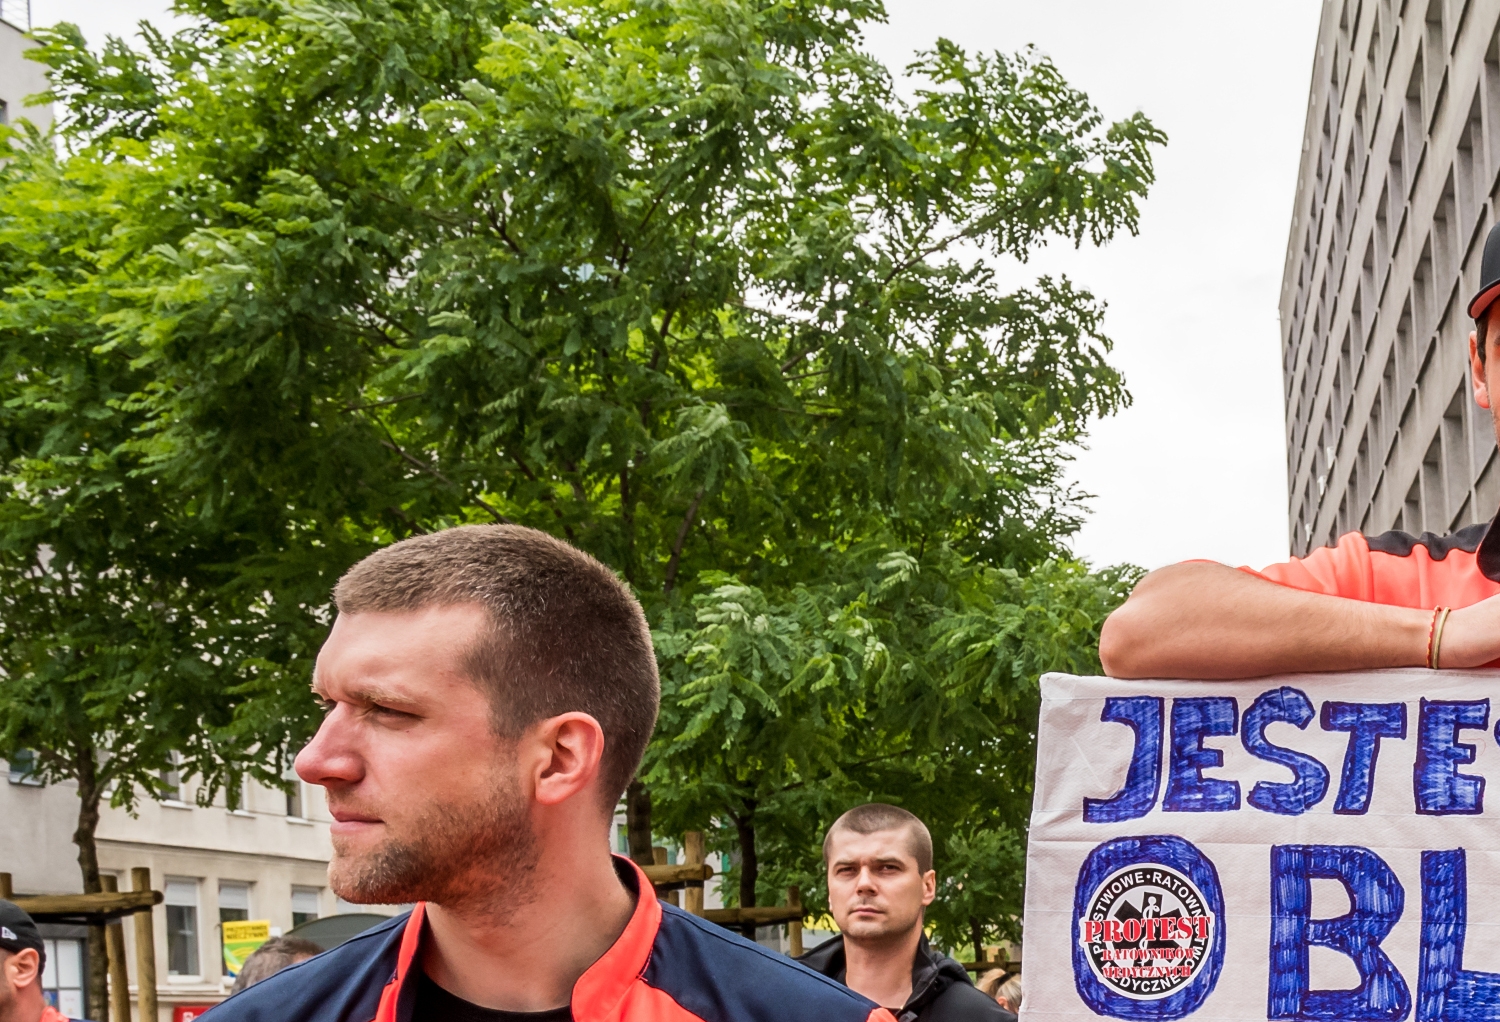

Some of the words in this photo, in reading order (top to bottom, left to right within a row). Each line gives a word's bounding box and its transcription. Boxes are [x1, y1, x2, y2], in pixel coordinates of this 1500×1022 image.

[1084, 916, 1211, 943] PROTEST
[1102, 947, 1195, 961] RATOWNIKÓW
[1102, 965, 1192, 978] MEDYCZNYCH
